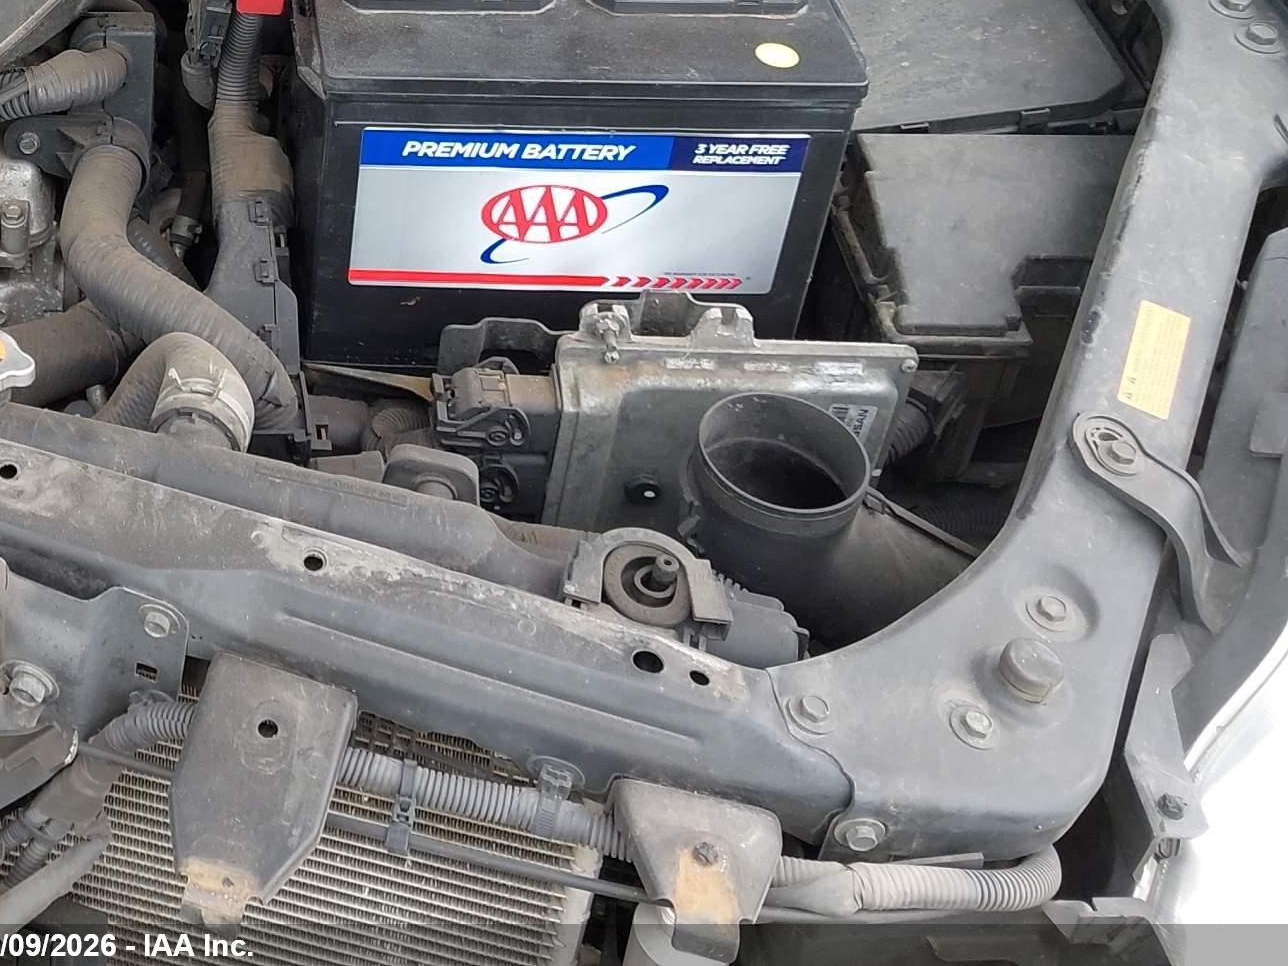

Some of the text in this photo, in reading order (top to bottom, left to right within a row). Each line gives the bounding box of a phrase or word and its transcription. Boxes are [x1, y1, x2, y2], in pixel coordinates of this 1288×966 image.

[402, 140, 637, 162] PREMIUM BATTERY
[694, 143, 791, 156] 3 YEAR FREE
[692, 155, 787, 166] REPLACEMENT
[486, 185, 604, 243] AAA
